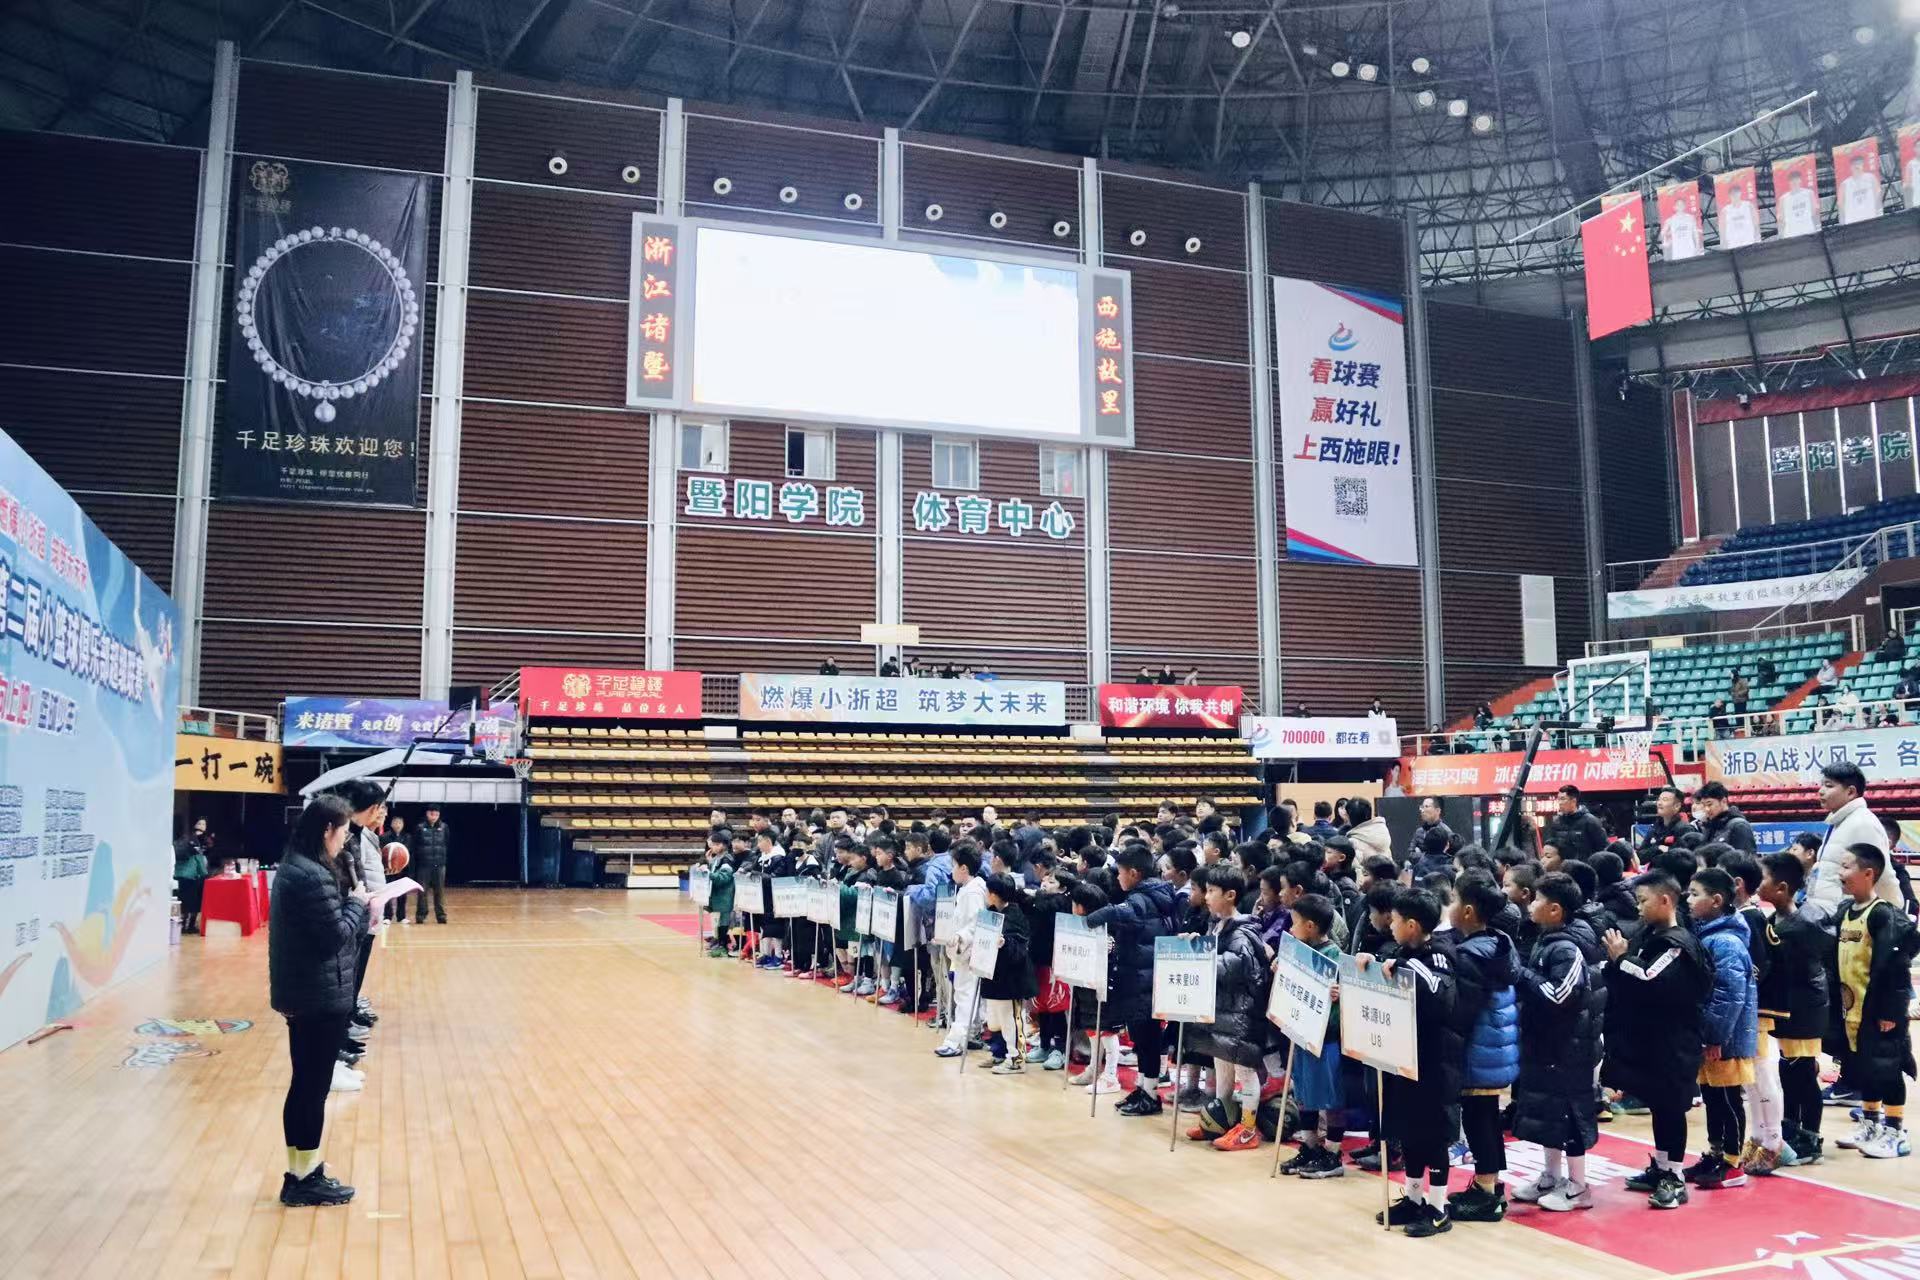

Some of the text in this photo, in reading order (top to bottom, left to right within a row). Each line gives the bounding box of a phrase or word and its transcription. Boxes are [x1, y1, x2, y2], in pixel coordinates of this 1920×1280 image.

[640, 236, 674, 381] 浙江诸暨
[1095, 295, 1122, 414] 西施故里
[1309, 357, 1381, 388] 看球赛
[1310, 396, 1381, 427] 赢好礼
[1772, 430, 1912, 475] 暨阳学院
[685, 476, 1076, 540] 暨阳学院 体育中心
[627, 691, 663, 699] PEARL
[760, 685, 1048, 715] 燃爆小浙超 筑梦大未来
[1108, 697, 1234, 716] 和谐环境 你我共创
[295, 712, 354, 731] 来诸暨
[1282, 730, 1370, 745] 700000 都在看
[175, 747, 282, 784] 一打一碗
[1723, 739, 1920, 776] 浙BA战火风云 各
[1371, 1033, 1382, 1048] U8
